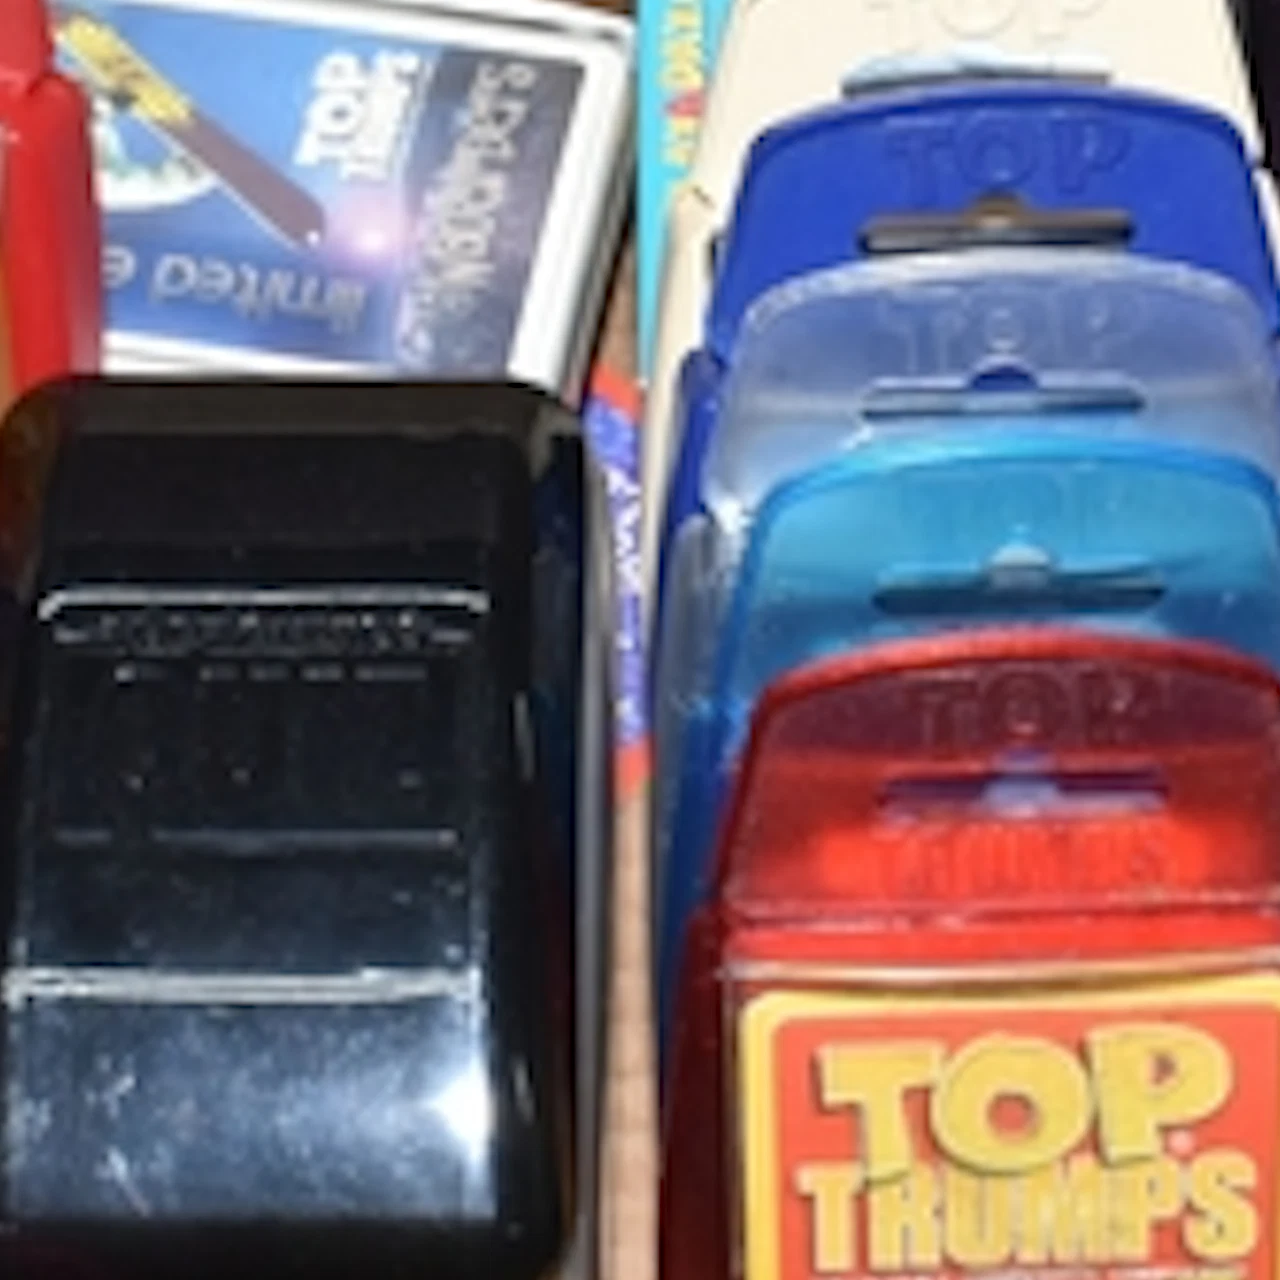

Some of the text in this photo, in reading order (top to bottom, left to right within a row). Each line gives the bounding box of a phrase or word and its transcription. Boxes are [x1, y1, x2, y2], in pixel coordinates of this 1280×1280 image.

[292, 52, 366, 167] TOP
[880, 113, 1132, 208] TOP
[814, 1022, 1234, 1182] TOP
[796, 1148, 1260, 1276] TRUMPS
